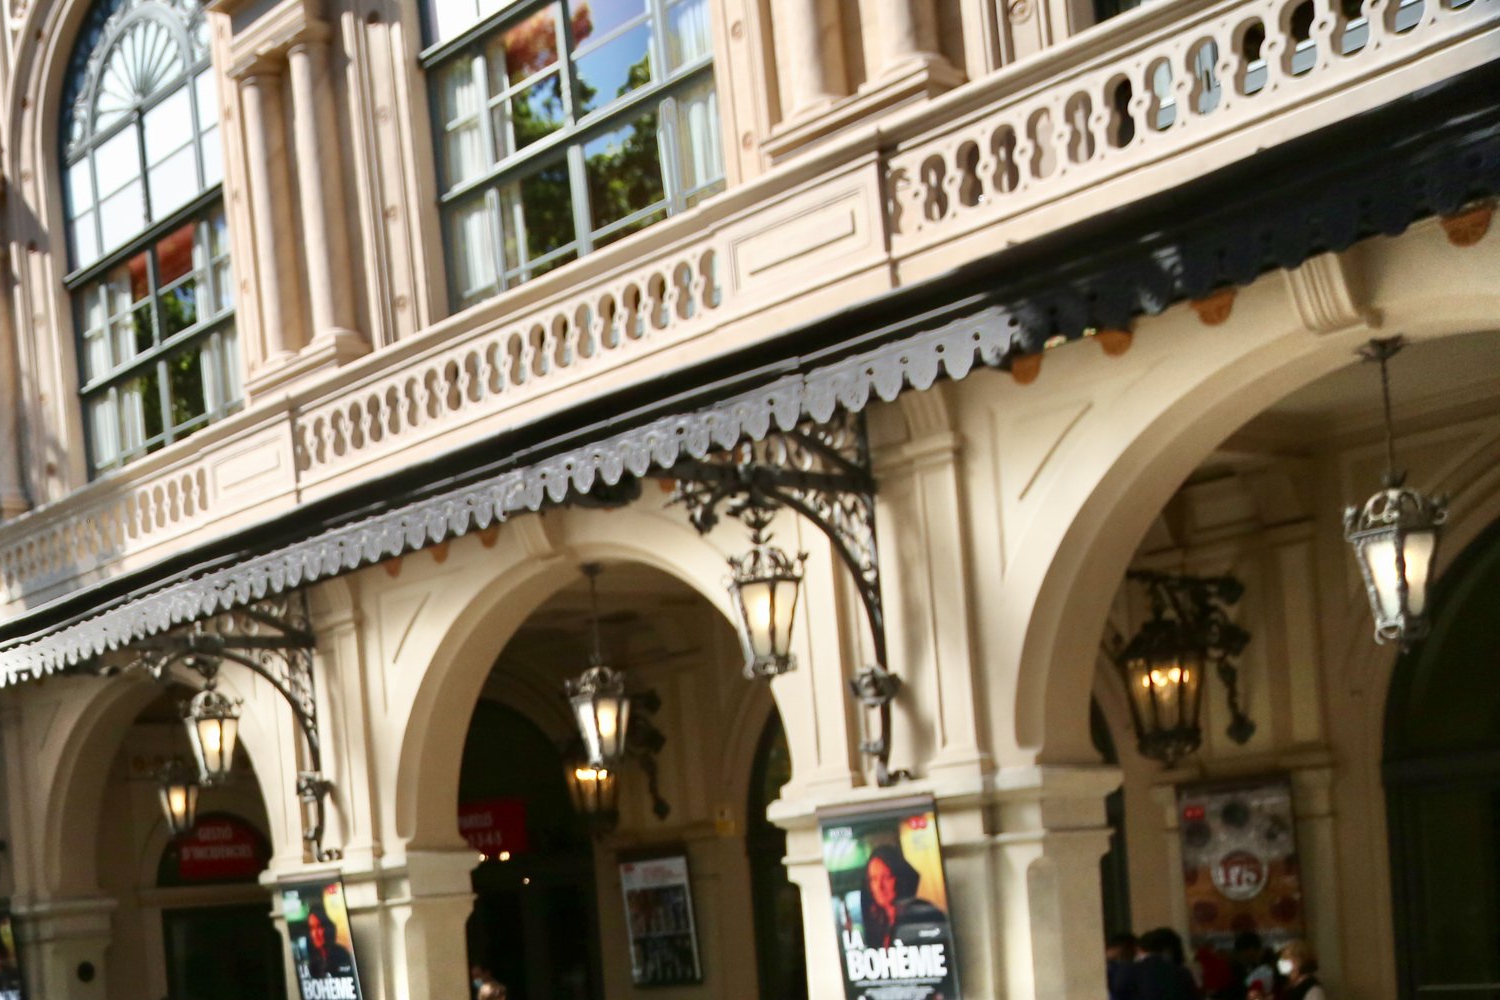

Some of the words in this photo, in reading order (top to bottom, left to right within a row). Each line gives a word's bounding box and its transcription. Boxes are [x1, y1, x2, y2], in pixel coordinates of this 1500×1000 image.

[843, 928, 865, 950] LA
[847, 938, 948, 981] BOHÈME
[302, 972, 357, 1000] BOHÈME
